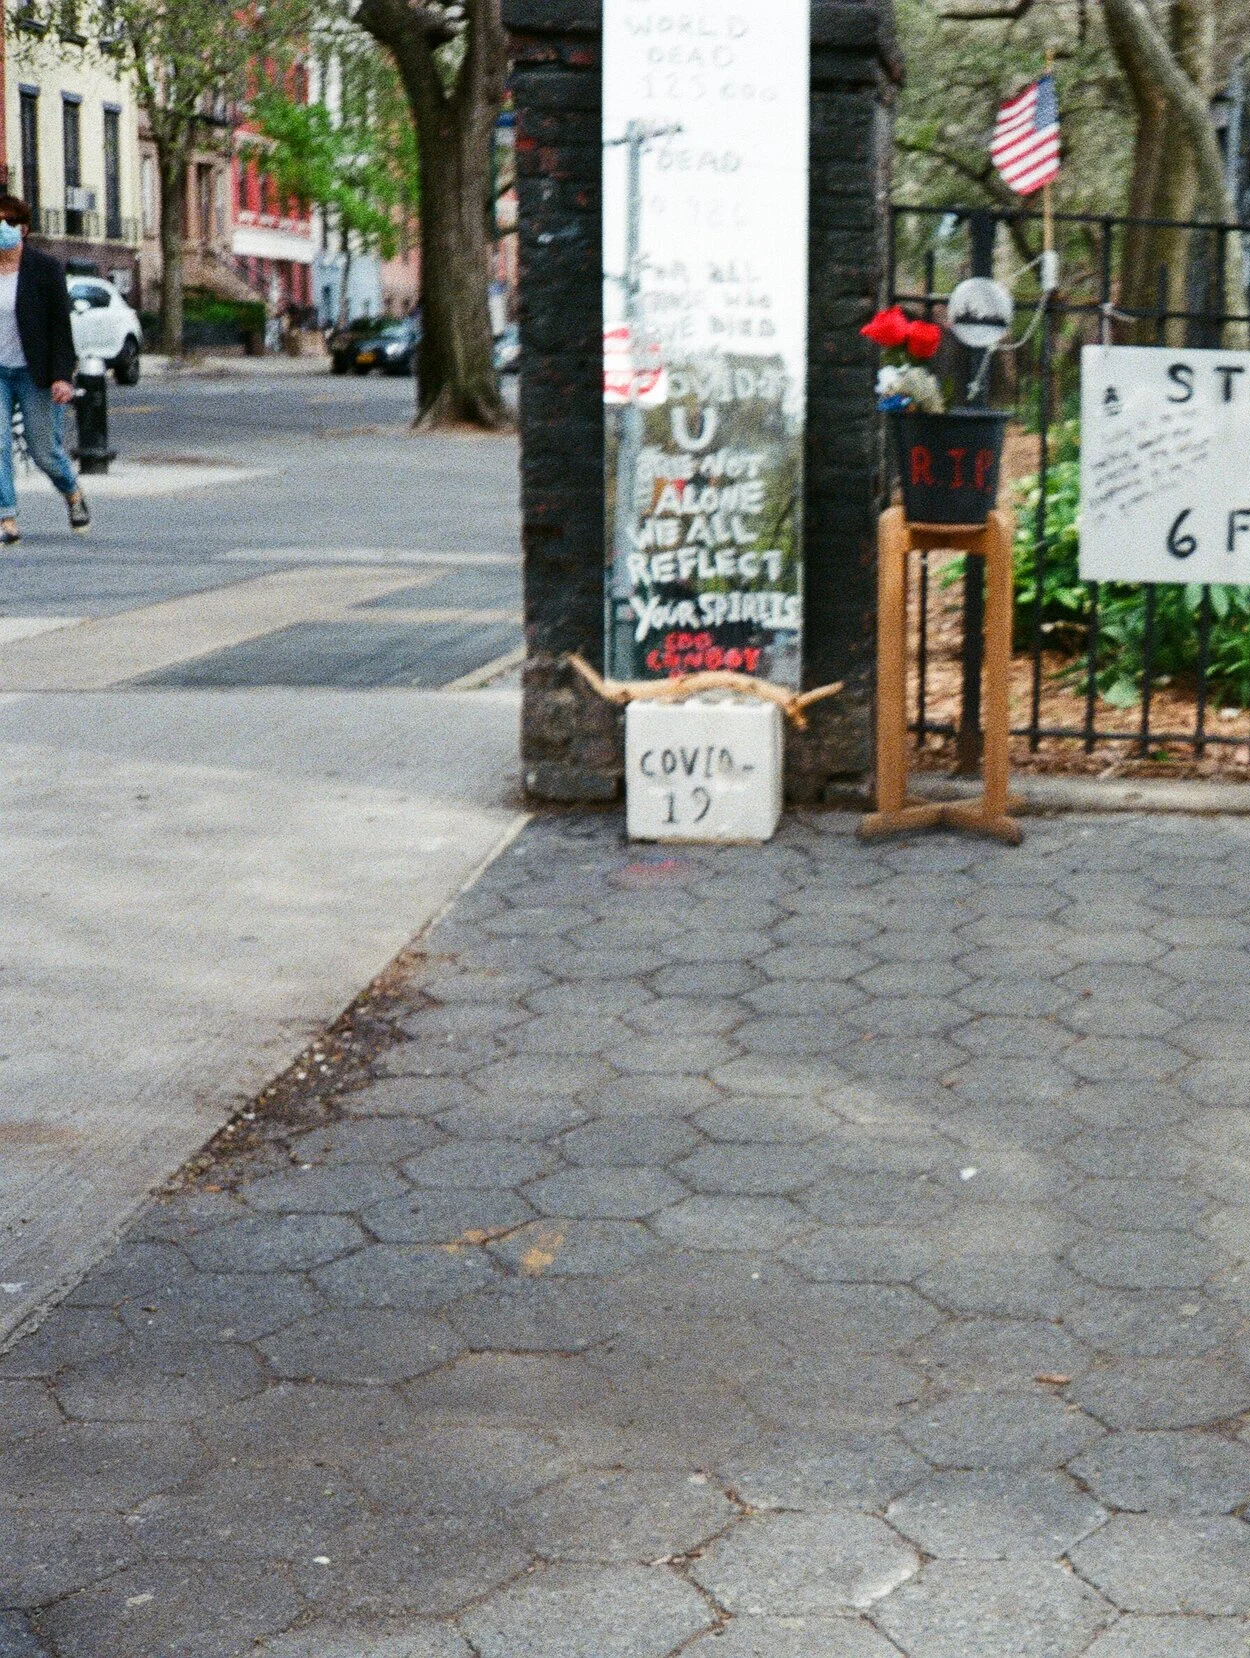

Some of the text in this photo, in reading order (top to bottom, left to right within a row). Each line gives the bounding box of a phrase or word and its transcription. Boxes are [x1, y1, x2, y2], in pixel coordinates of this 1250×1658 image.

[670, 405, 719, 451] U
[699, 448, 768, 479] NOT
[654, 481, 766, 517] ALONE
[627, 511, 760, 551] WE ALL
[1166, 507, 1198, 560] 6
[627, 546, 784, 587] REFLECT
[661, 786, 712, 825] 19
